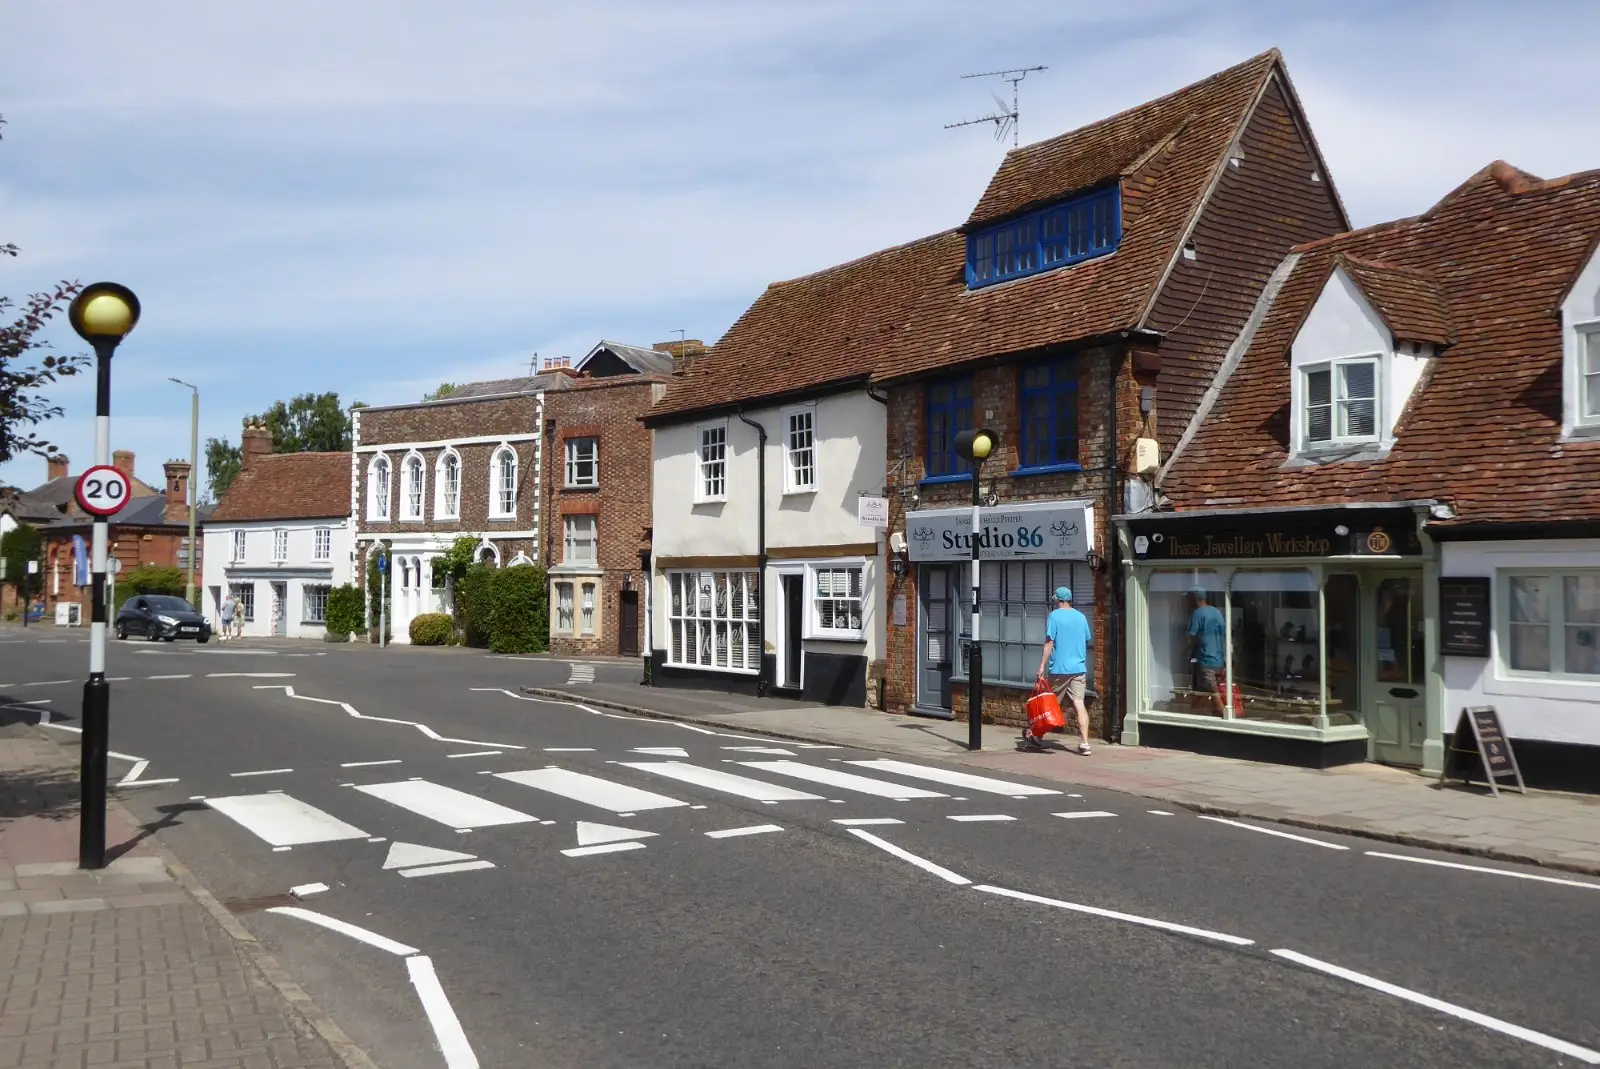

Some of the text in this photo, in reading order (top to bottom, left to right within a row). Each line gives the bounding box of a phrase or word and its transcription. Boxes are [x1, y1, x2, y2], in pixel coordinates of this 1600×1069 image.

[87, 479, 123, 499] 20
[942, 525, 1044, 550] Studio 86
[1167, 532, 1330, 556] Thame Jewellery Workshop
